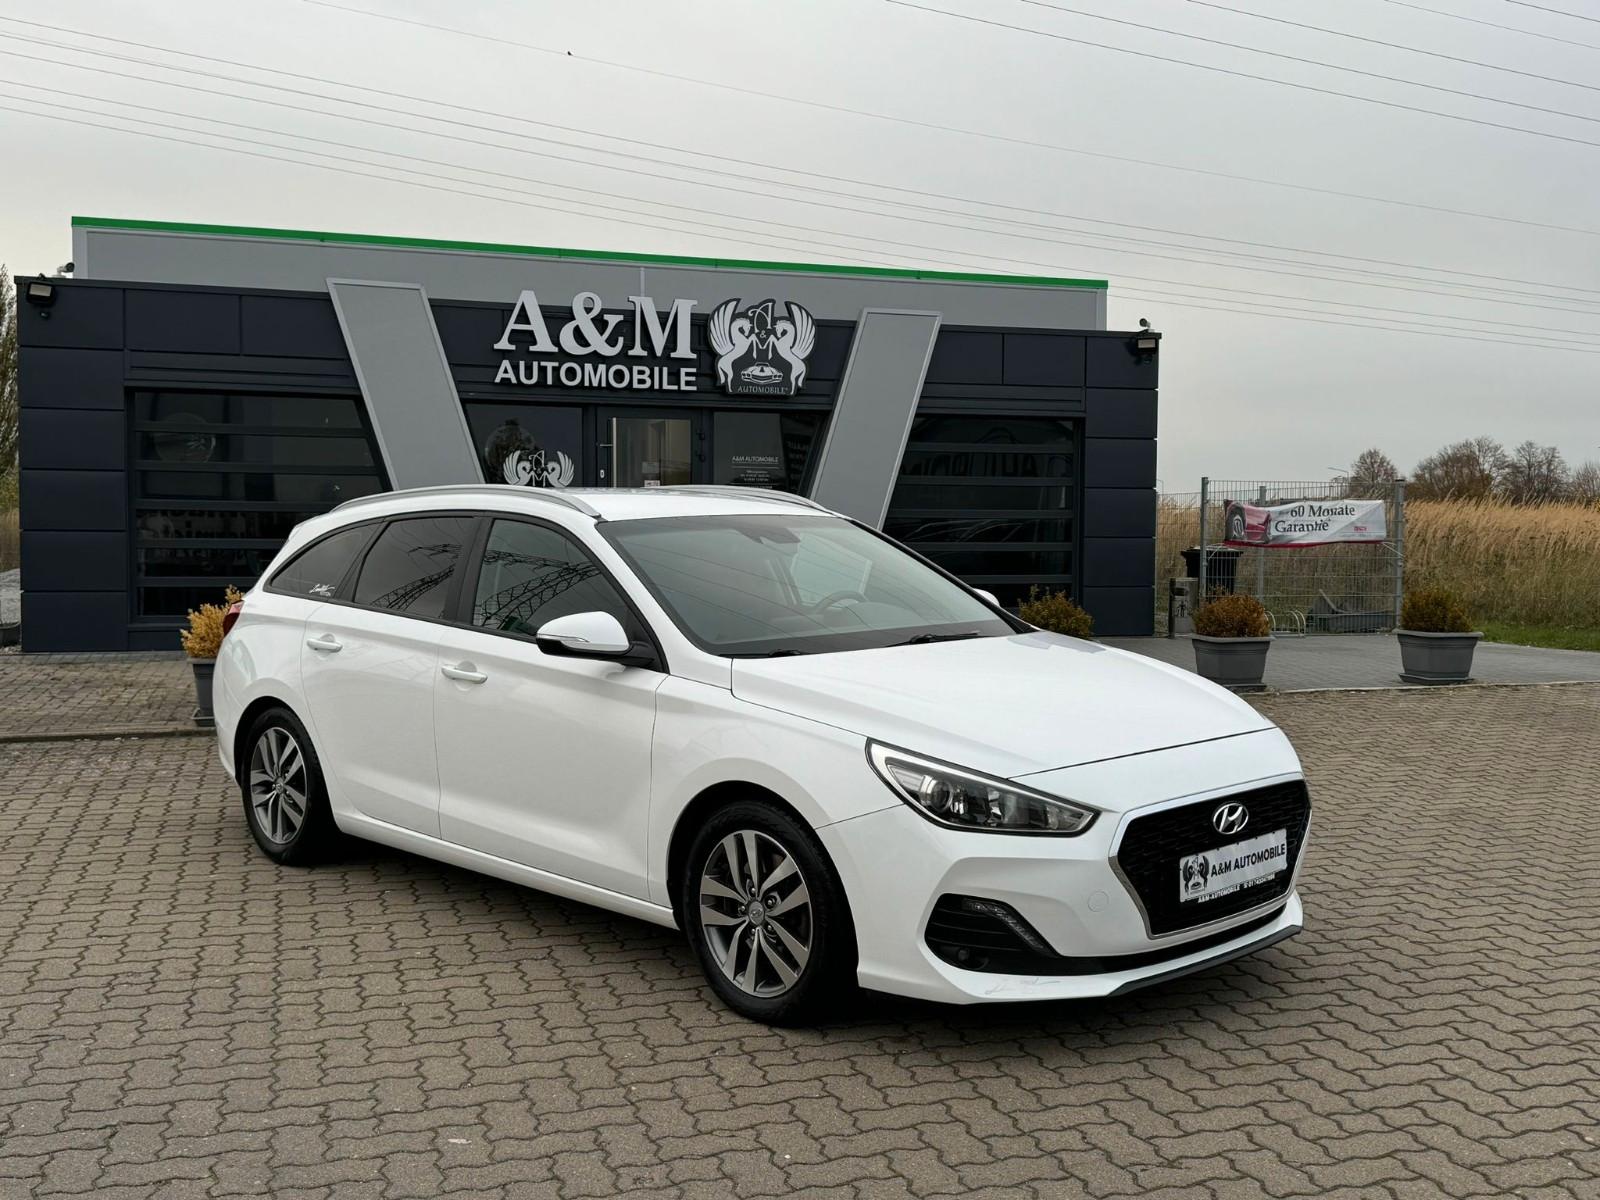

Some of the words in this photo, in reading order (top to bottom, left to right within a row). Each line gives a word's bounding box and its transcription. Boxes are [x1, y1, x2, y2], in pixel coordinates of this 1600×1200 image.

[493, 290, 698, 359] A&M
[494, 359, 698, 391] AUTOMOBILE
[1290, 504, 1305, 518] 60
[1308, 504, 1356, 518] Monate
[1211, 860, 1232, 877] A&M
[1233, 844, 1285, 870] AUTOMOBILE
